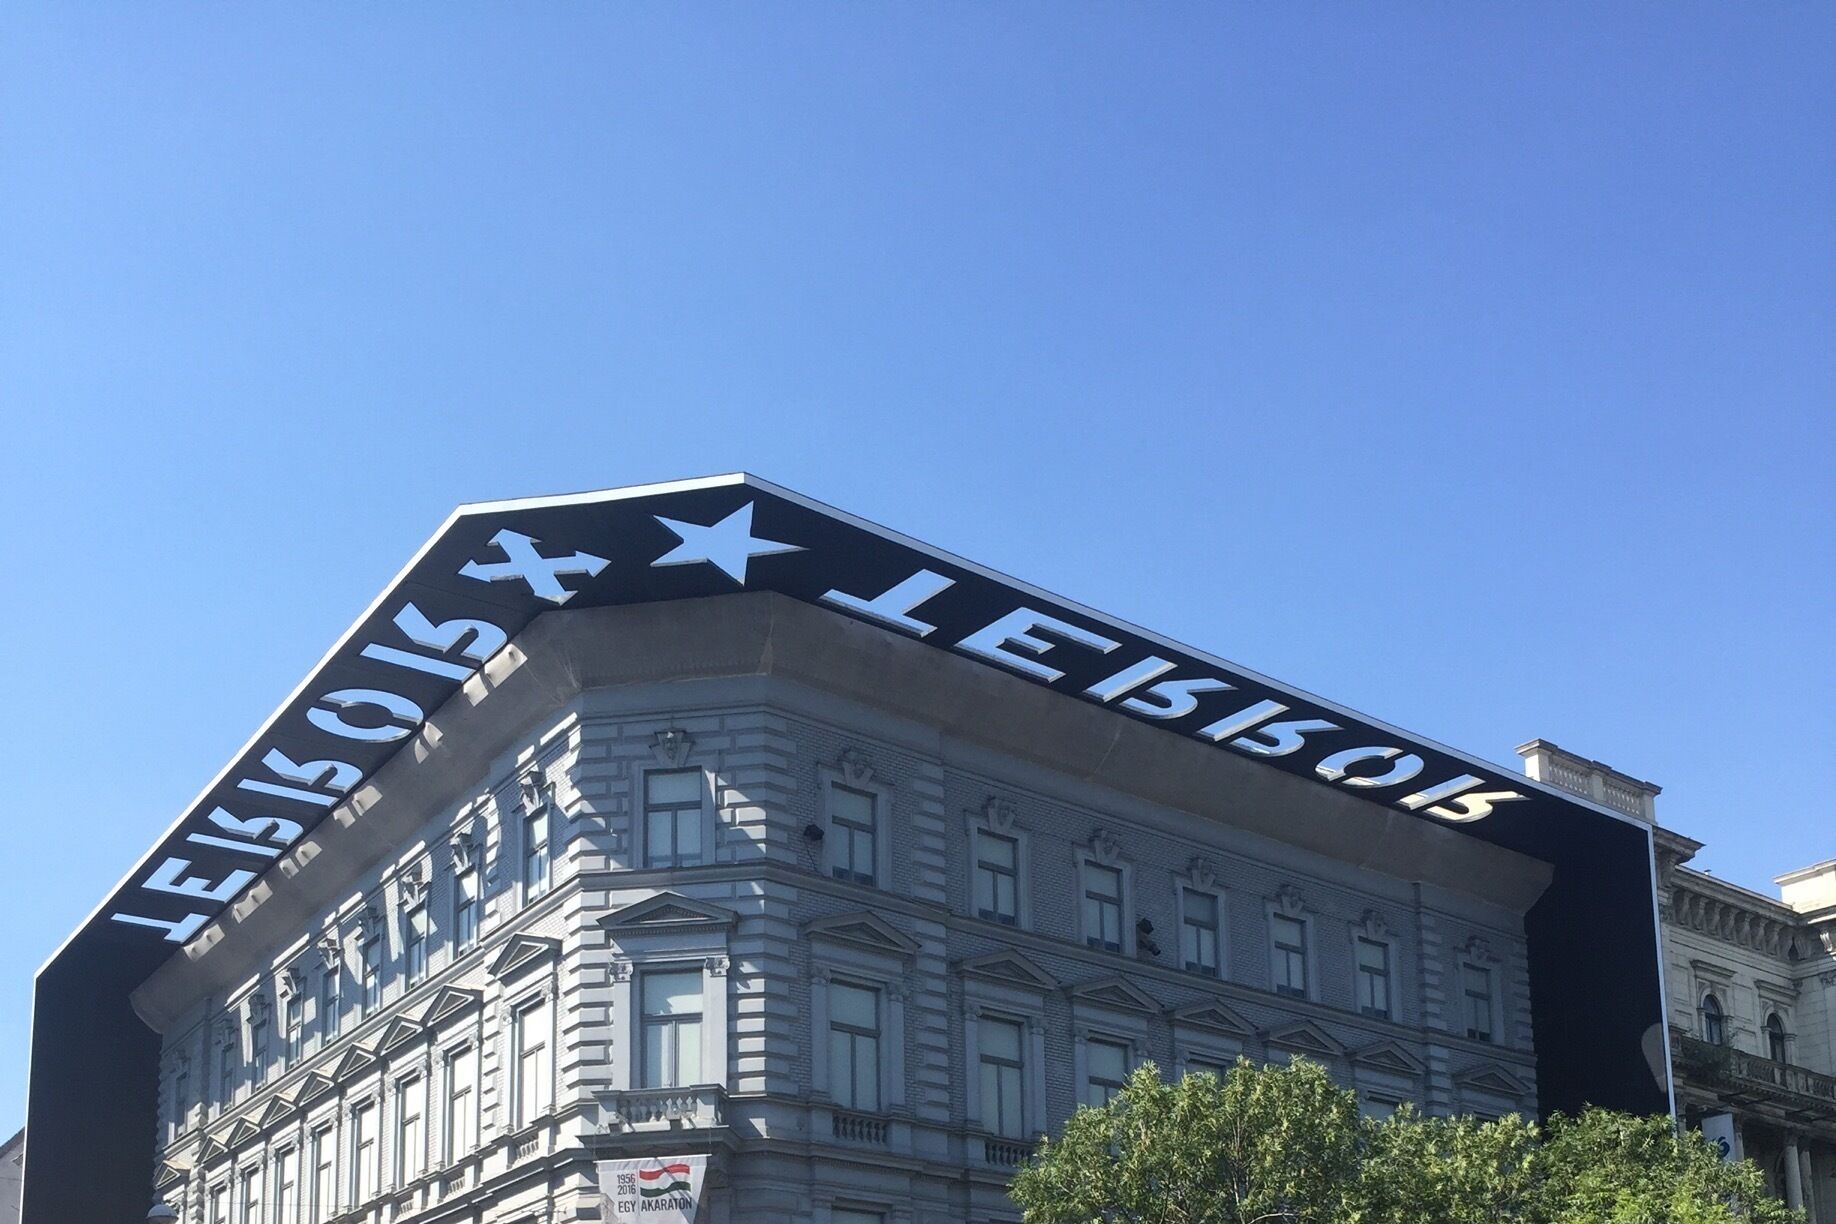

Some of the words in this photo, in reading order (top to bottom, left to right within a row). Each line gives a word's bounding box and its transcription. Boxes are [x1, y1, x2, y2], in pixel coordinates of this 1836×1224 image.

[617, 1173, 636, 1185] 1956
[618, 1184, 636, 1195] 2016
[618, 1200, 636, 1213] EGY
[641, 1197, 692, 1212] AKARATON
